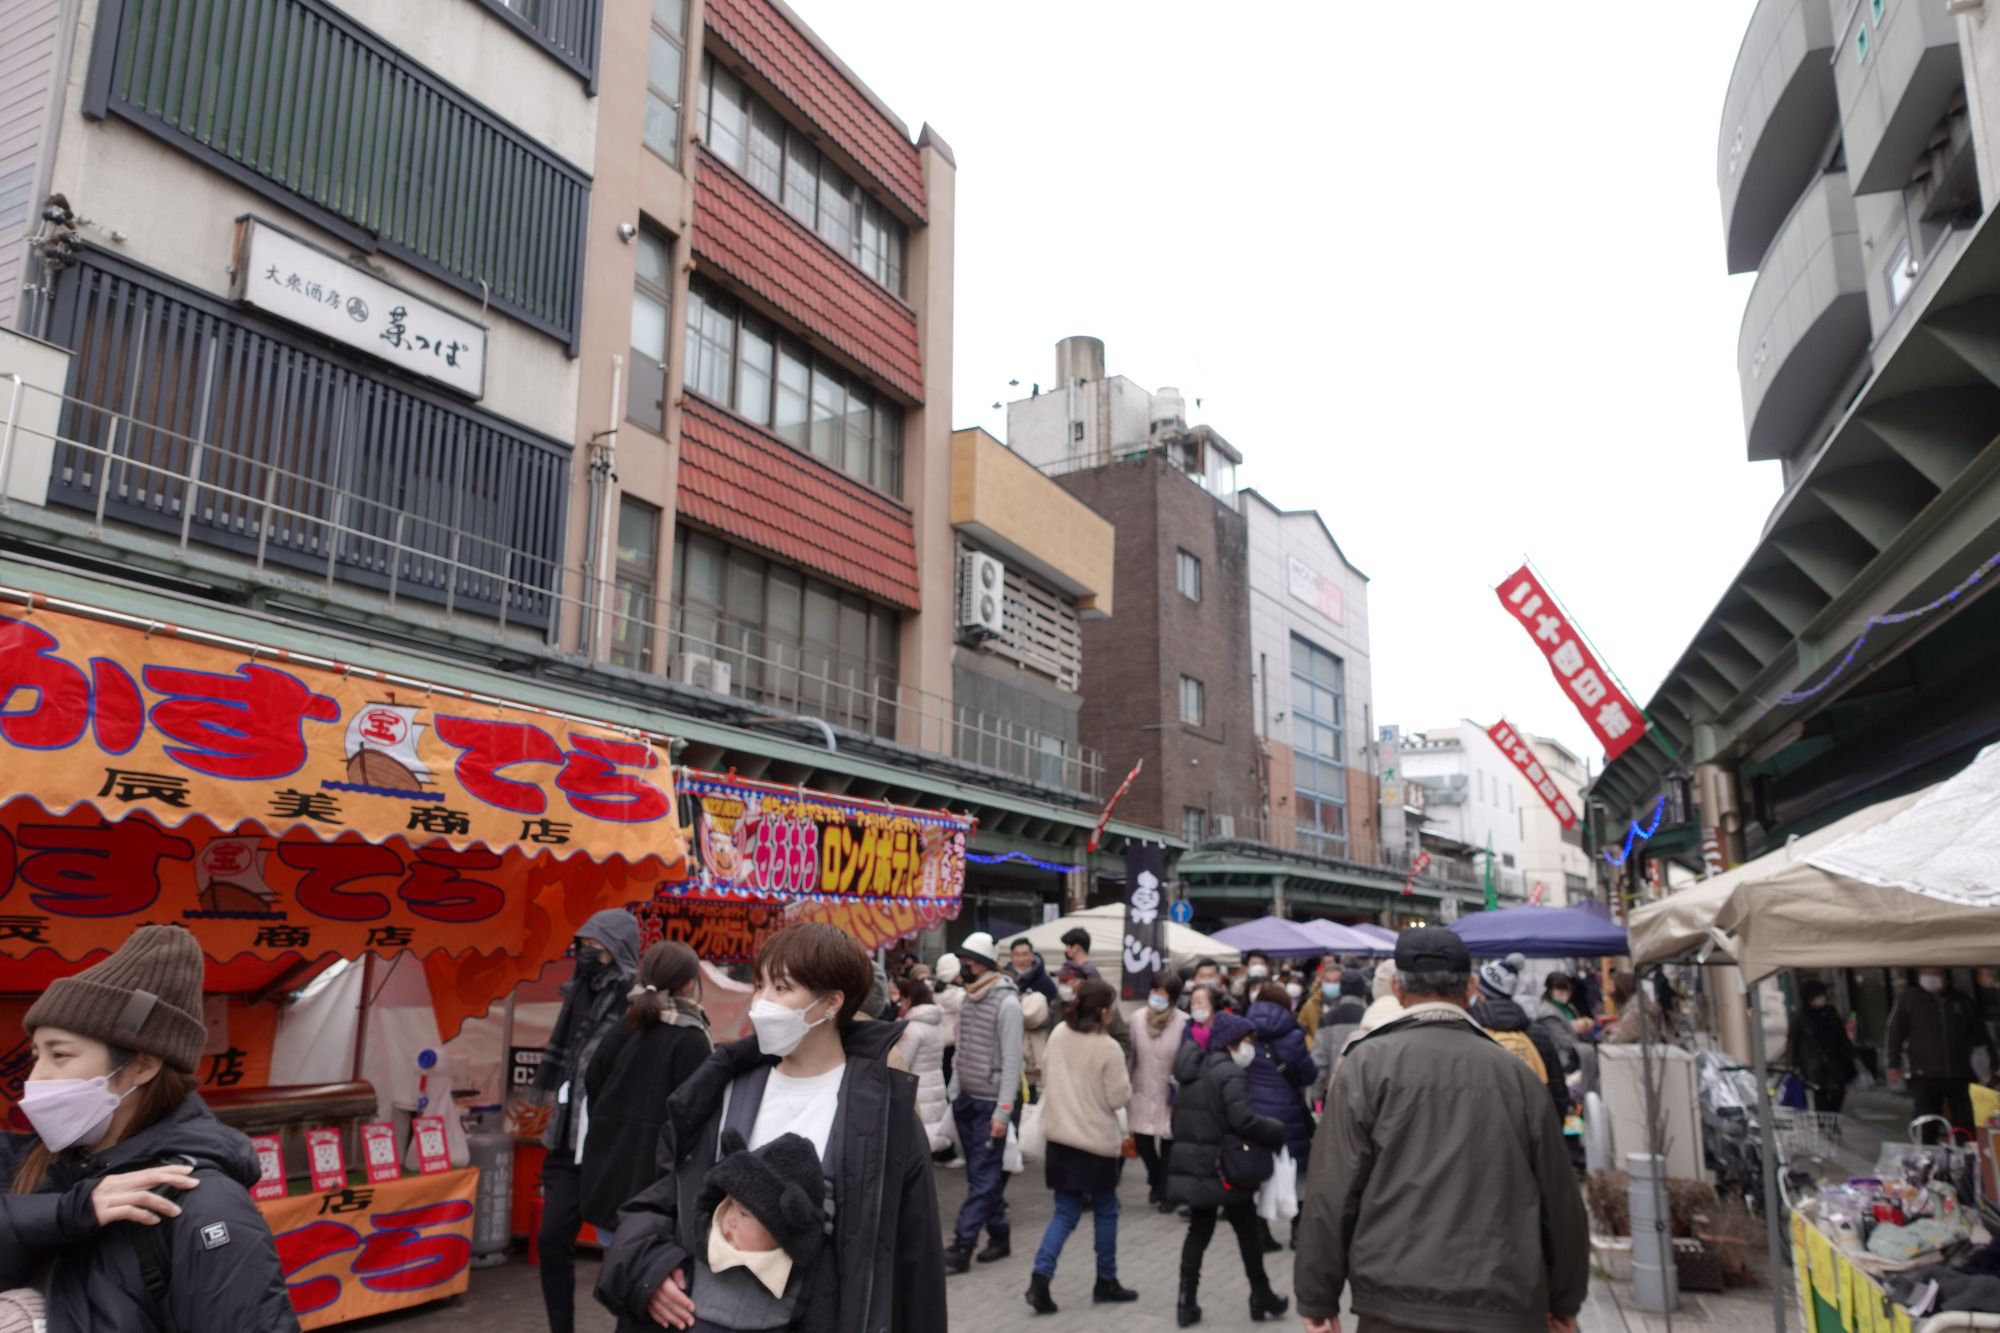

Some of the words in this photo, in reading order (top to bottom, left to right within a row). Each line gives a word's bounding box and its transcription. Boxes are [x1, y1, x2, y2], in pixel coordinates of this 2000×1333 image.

[264, 263, 342, 309] 大衆酒房
[821, 825, 921, 899] ロングポテト
[205, 1047, 246, 1086] 店
